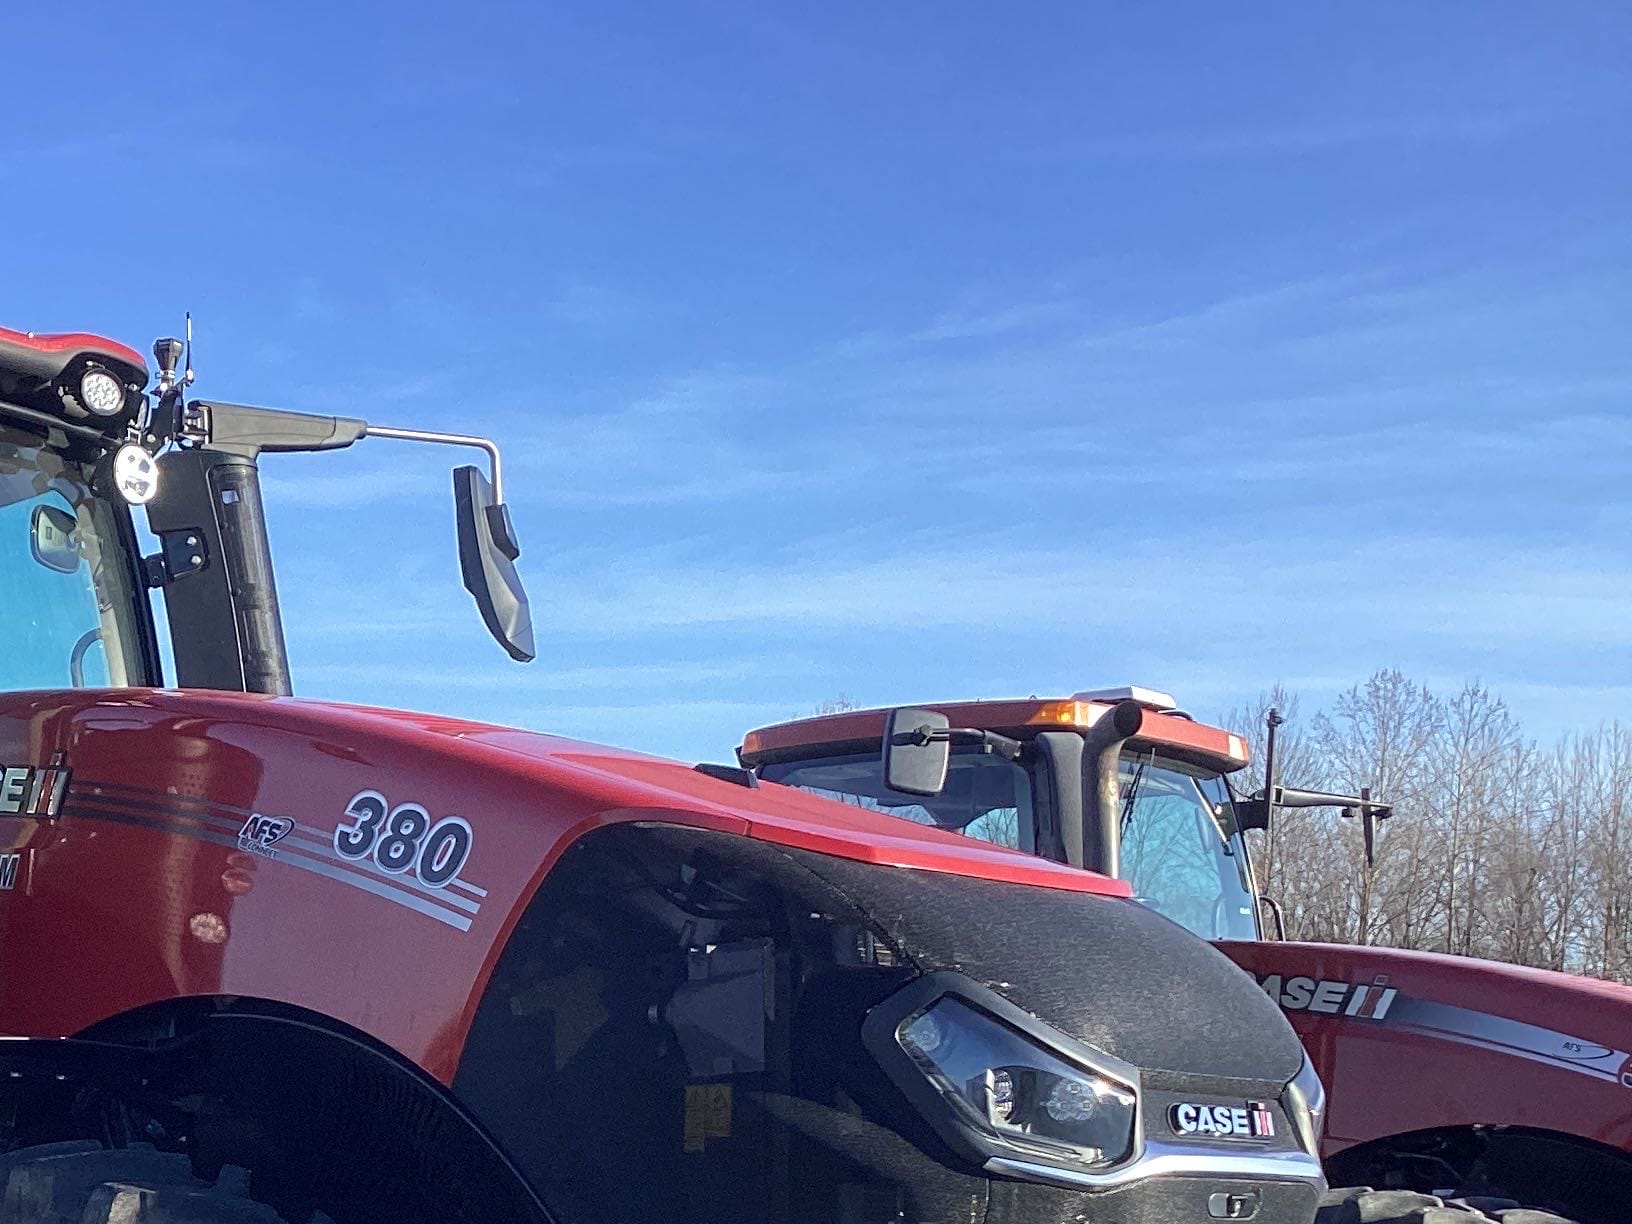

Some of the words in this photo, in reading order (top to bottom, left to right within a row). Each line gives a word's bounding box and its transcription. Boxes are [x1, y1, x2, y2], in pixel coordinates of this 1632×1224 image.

[239, 814, 285, 845] AFS
[333, 789, 474, 889] 380
[1248, 970, 1349, 1014] ASE
[1562, 1041, 1582, 1053] AFS
[1177, 1103, 1251, 1134] CASE
